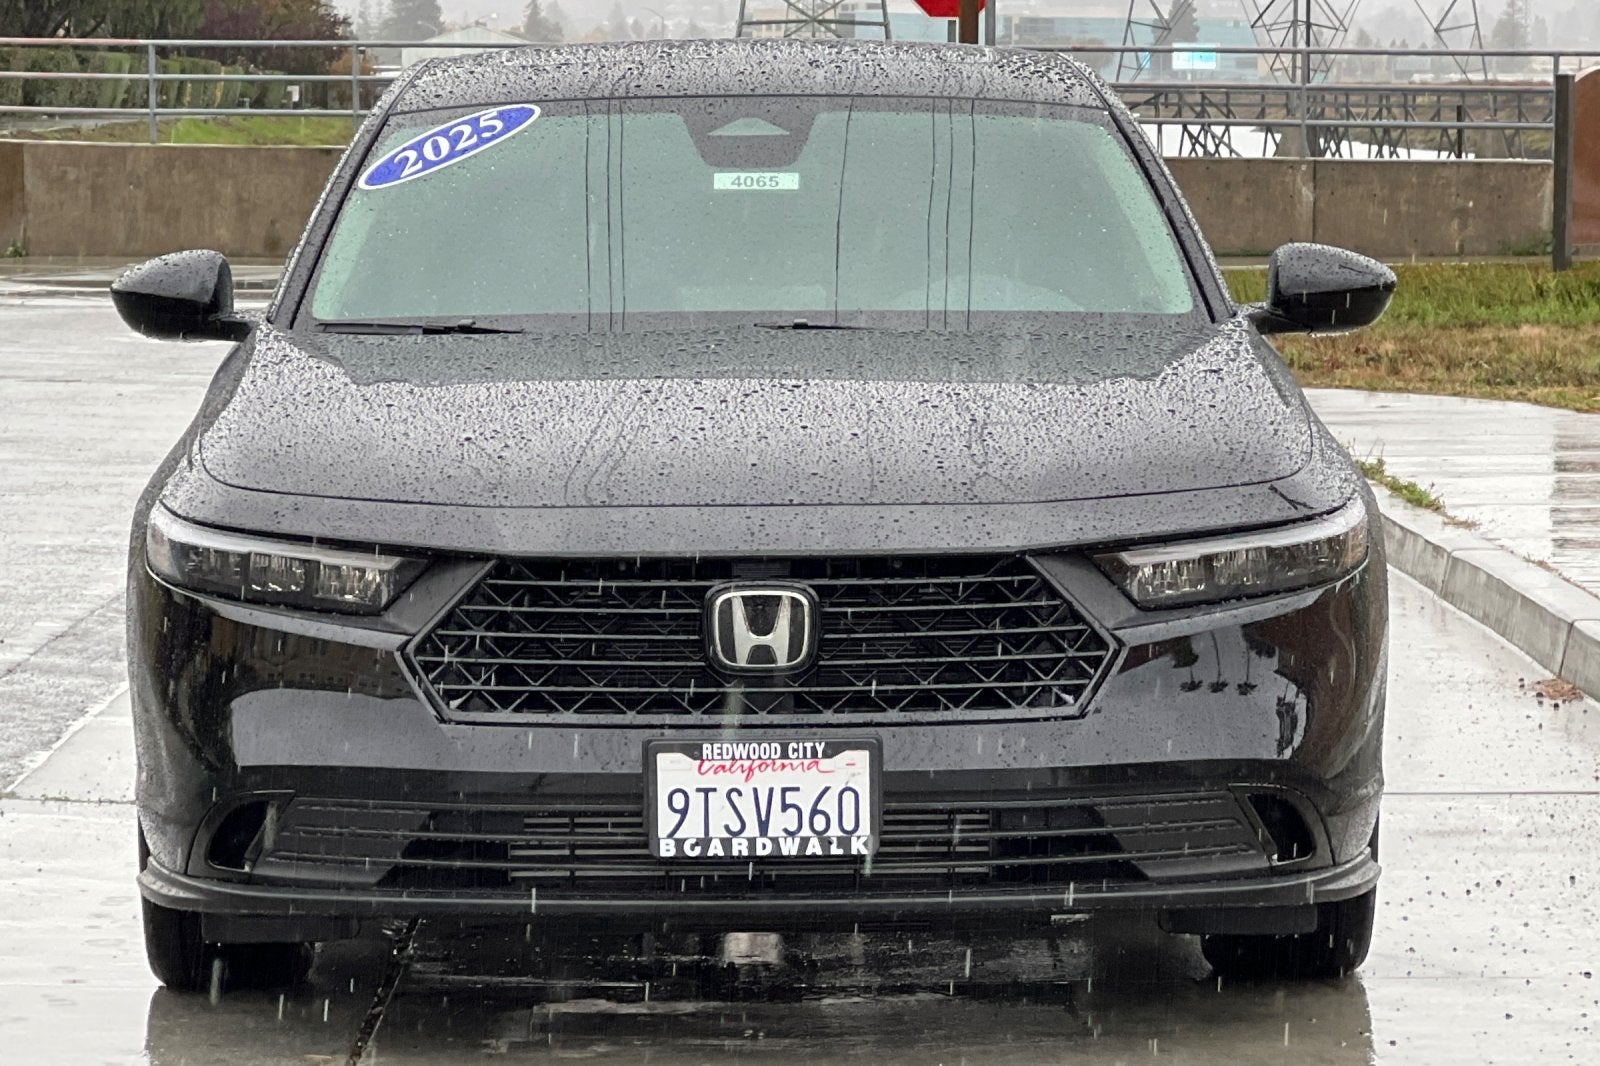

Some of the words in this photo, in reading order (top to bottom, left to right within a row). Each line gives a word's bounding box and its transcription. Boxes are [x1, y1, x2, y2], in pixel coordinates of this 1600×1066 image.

[394, 110, 503, 178] 2025
[730, 175, 780, 188] 4065
[702, 742, 781, 760] REDWOOD
[788, 742, 826, 759] CITY
[697, 758, 836, 783] California
[666, 786, 861, 838] 9TSV560
[659, 836, 869, 858] BOARDWALK
